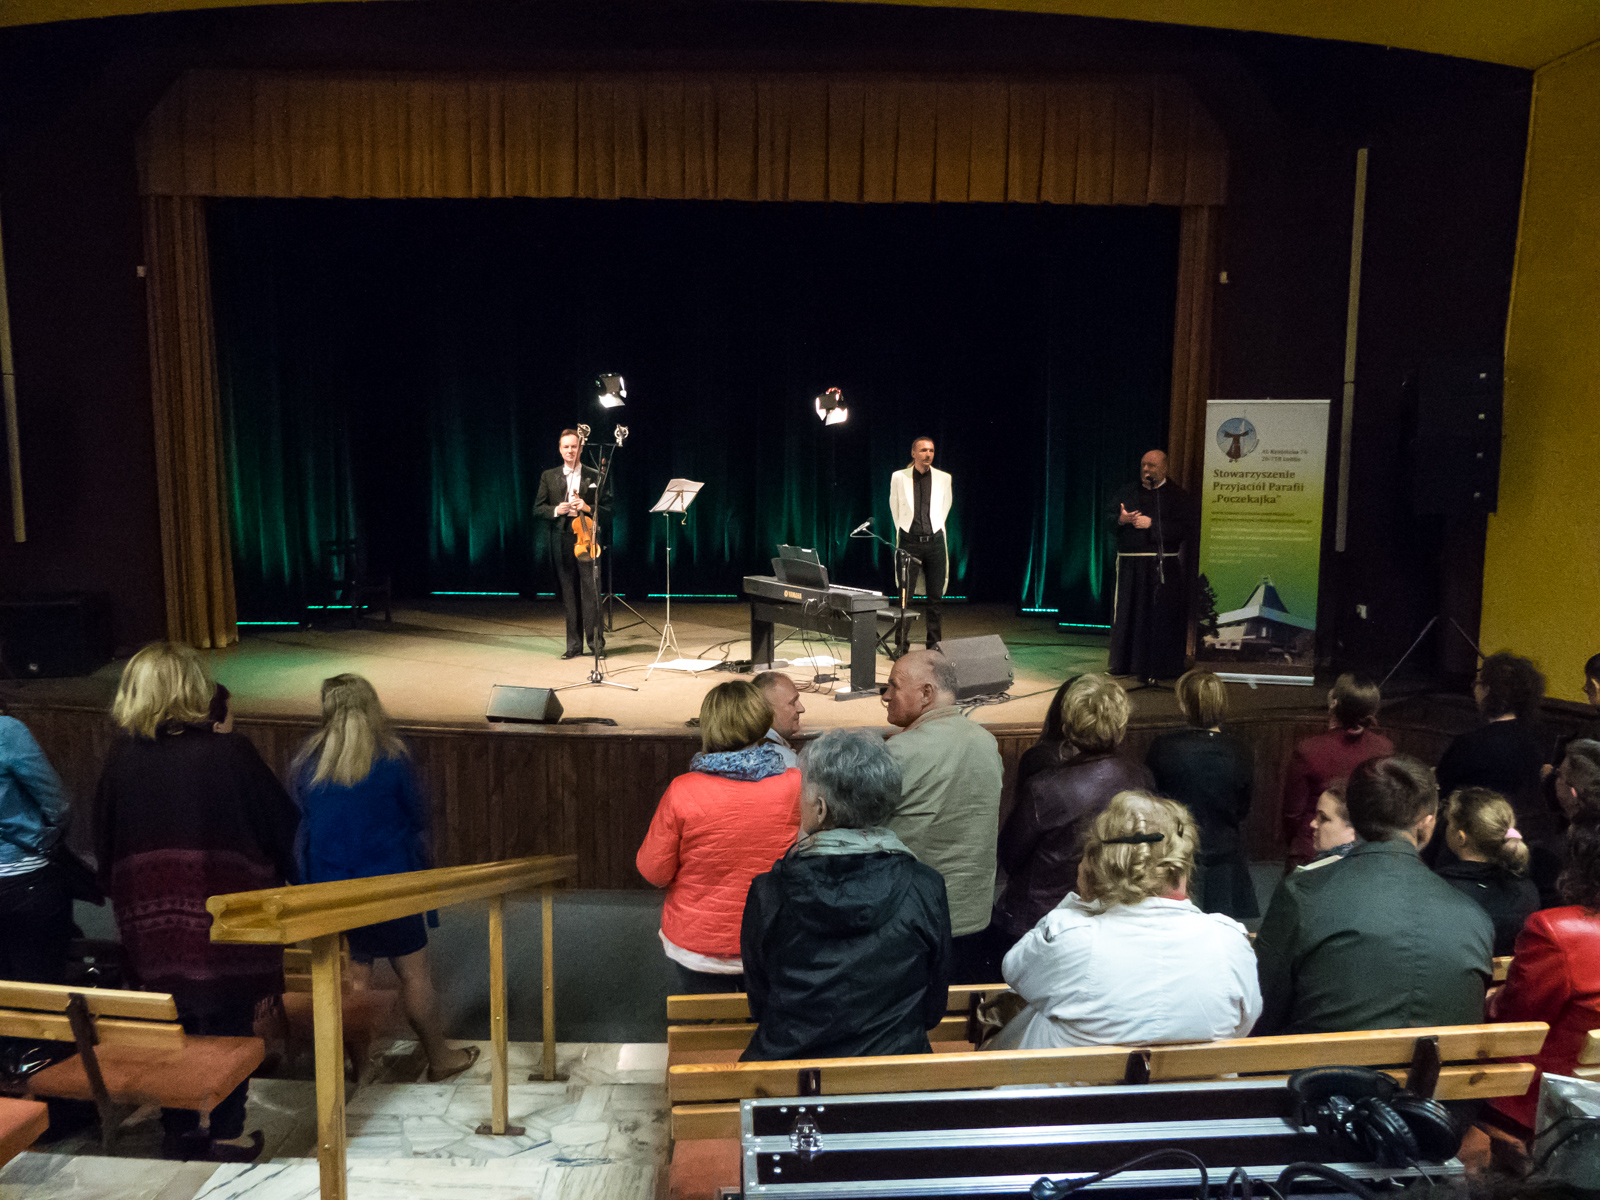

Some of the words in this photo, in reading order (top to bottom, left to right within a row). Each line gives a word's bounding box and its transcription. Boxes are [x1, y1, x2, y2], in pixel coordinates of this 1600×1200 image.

[1213, 469, 1295, 480] Stowarzyszenie
[1213, 481, 1266, 492] Przyjaciół
[1268, 482, 1304, 492] Parafii
